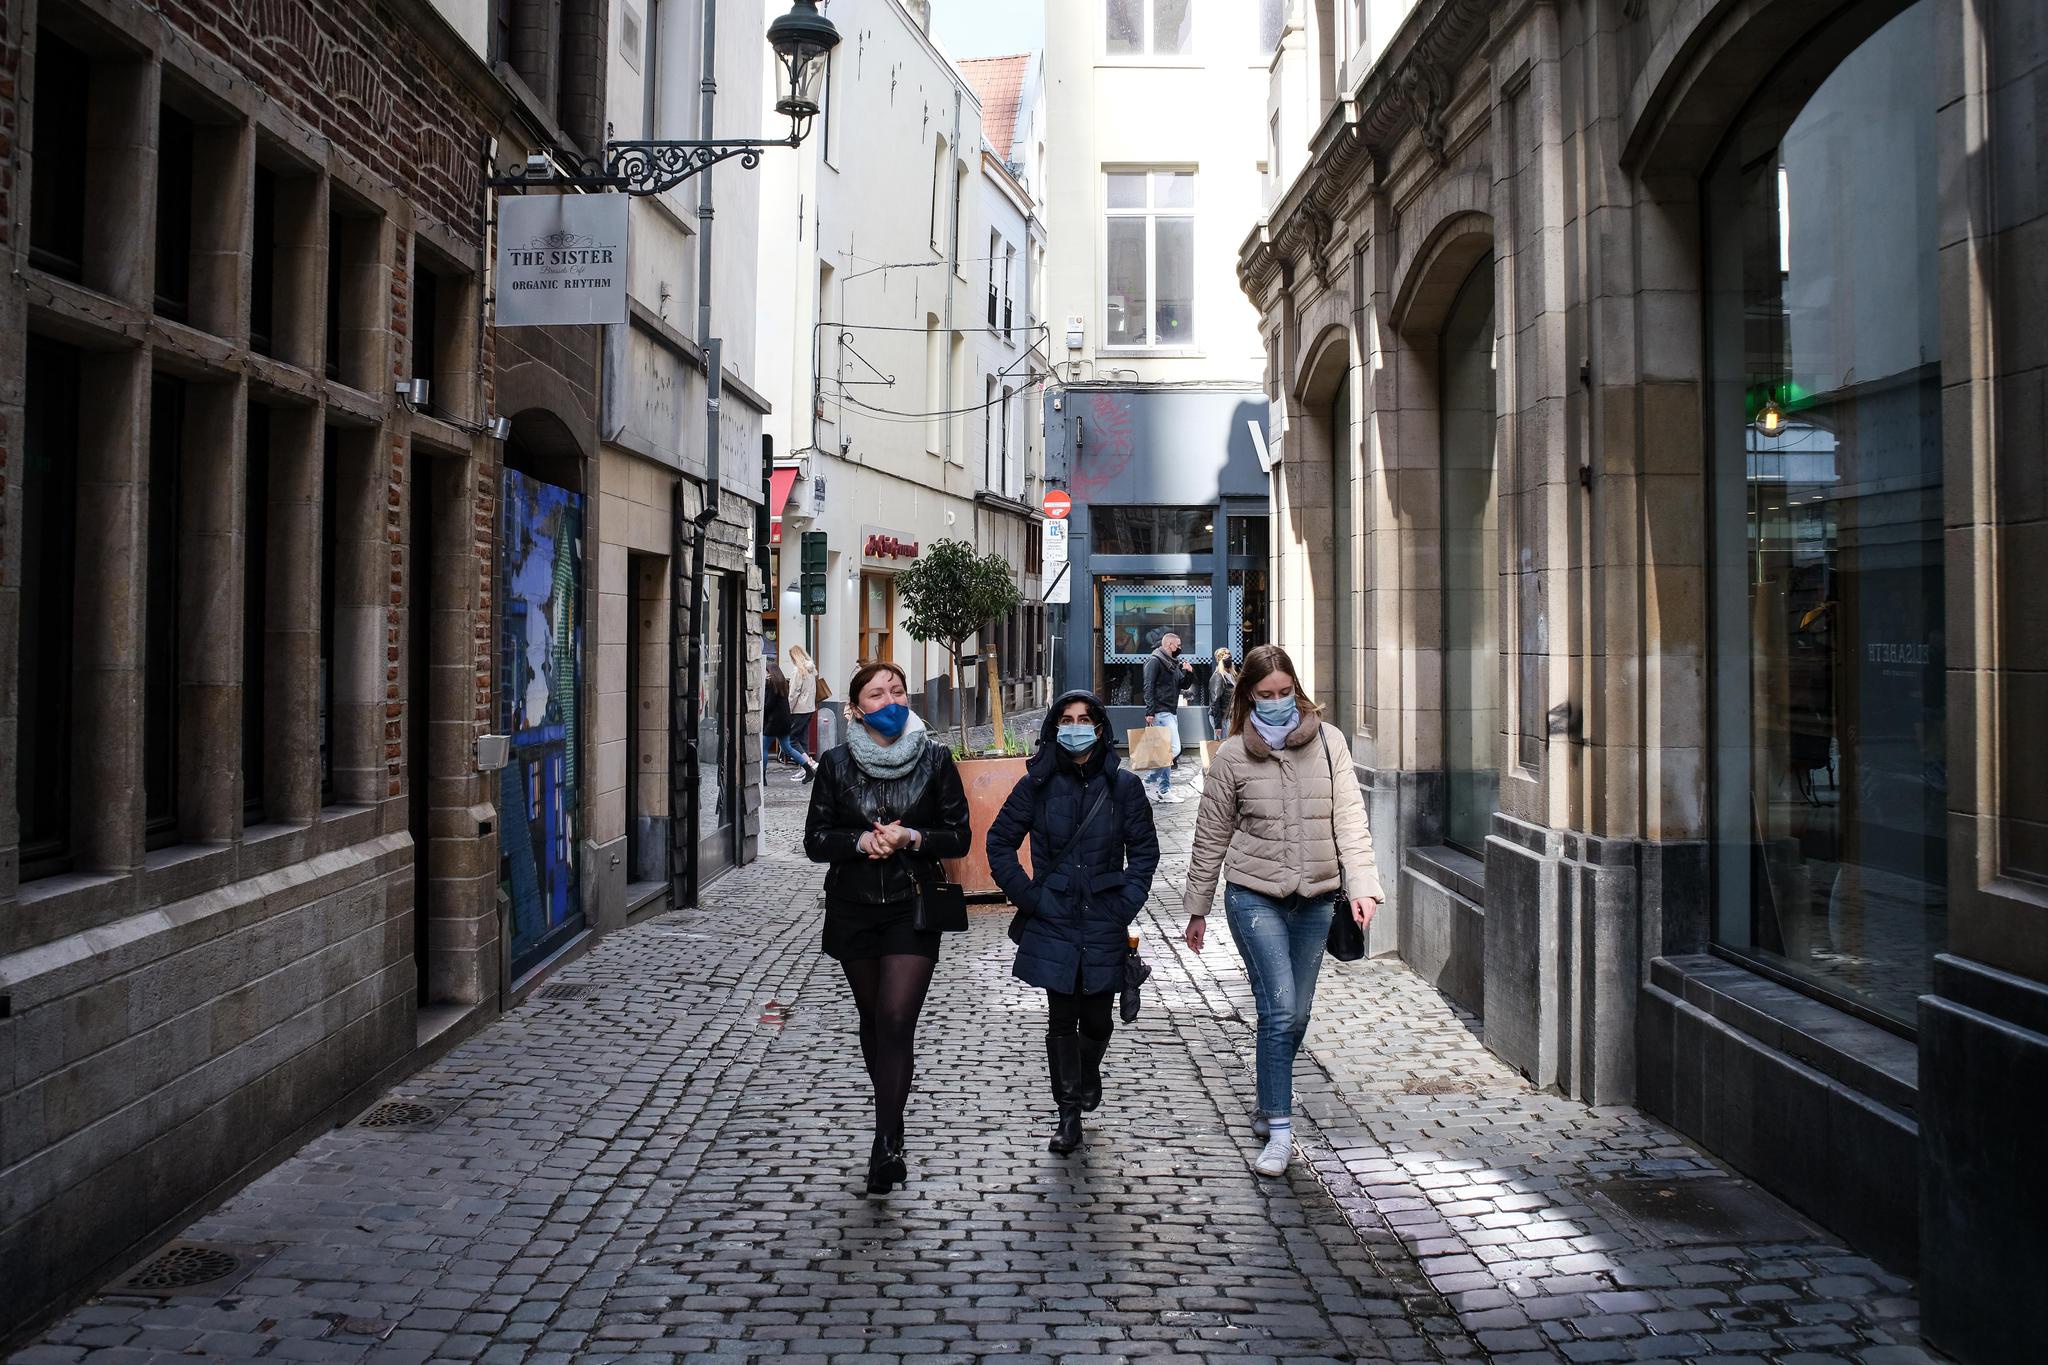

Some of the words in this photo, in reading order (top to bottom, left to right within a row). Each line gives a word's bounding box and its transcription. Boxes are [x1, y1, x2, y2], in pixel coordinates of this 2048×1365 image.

[510, 251, 545, 266] THE
[550, 249, 613, 265] SISTER
[512, 279, 559, 290] ORGANIC
[564, 278, 611, 289] RHYTHM
